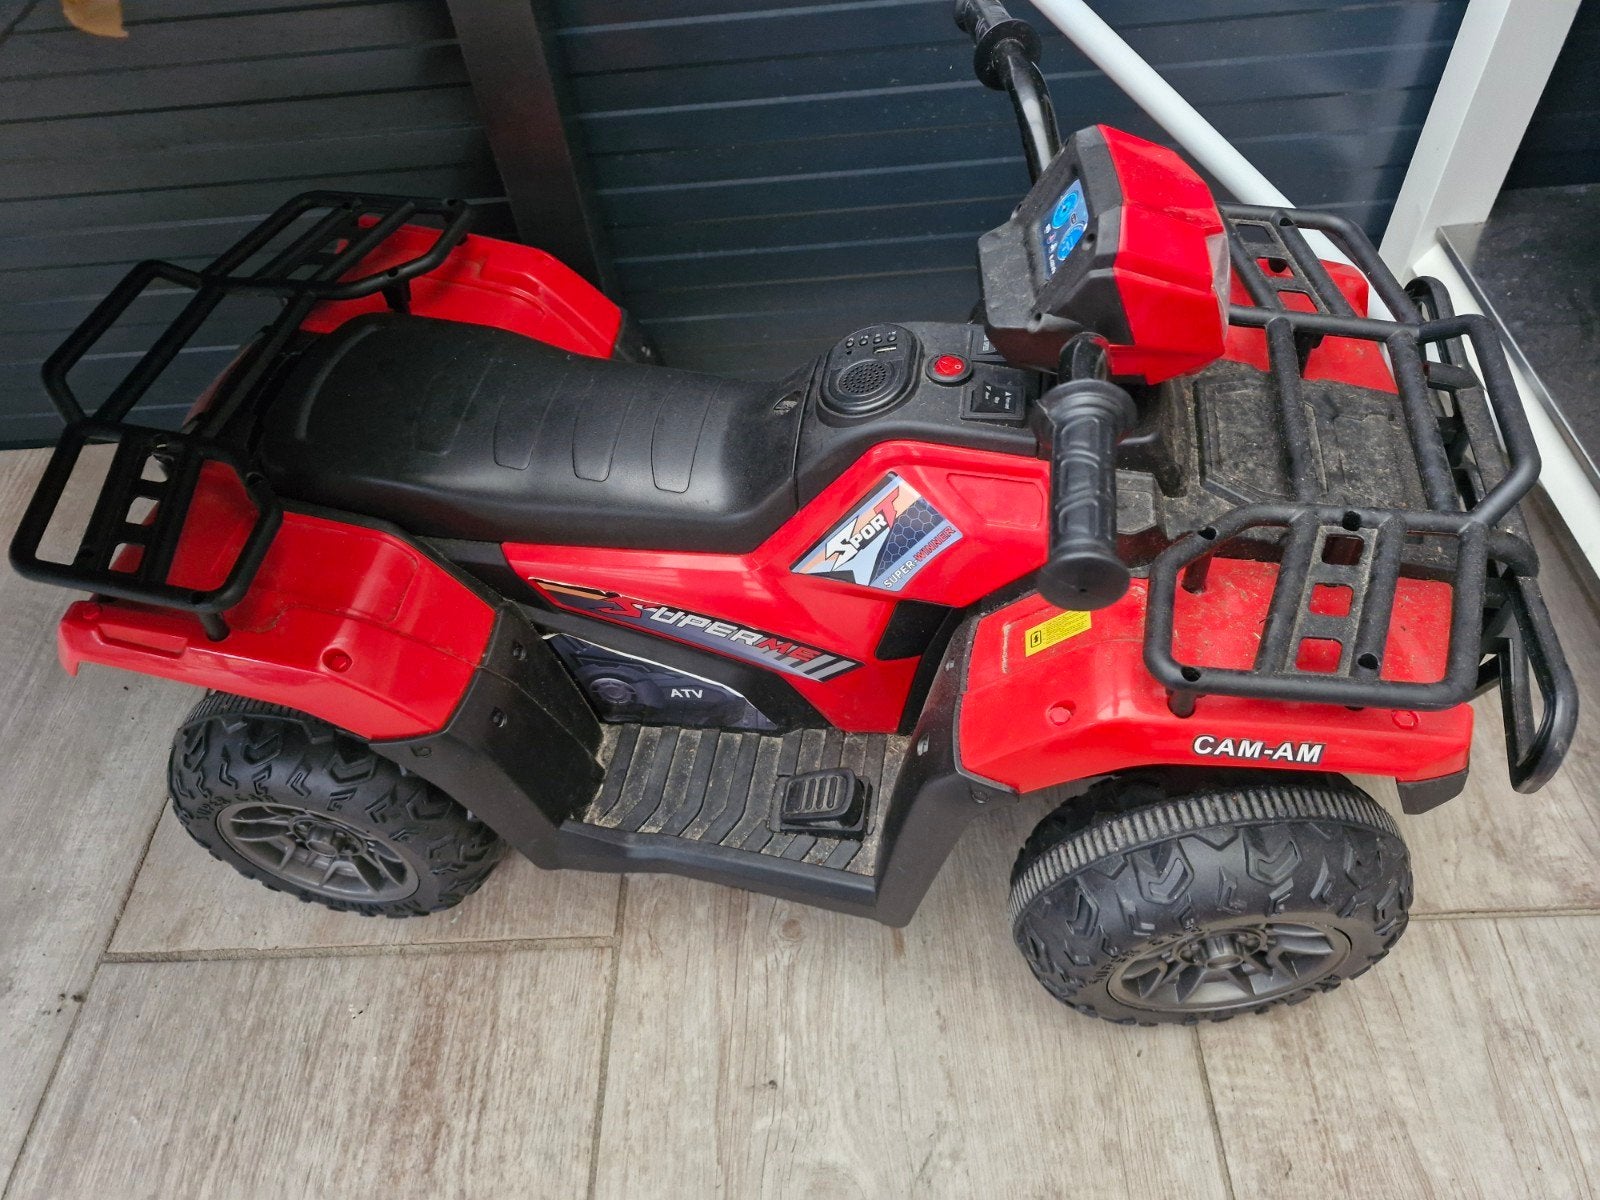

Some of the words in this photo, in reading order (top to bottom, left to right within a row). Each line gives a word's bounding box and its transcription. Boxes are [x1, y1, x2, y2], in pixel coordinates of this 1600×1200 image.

[825, 486, 900, 572] SPORT
[670, 688, 704, 699] ATV
[1193, 734, 1324, 764] CAM-AM
